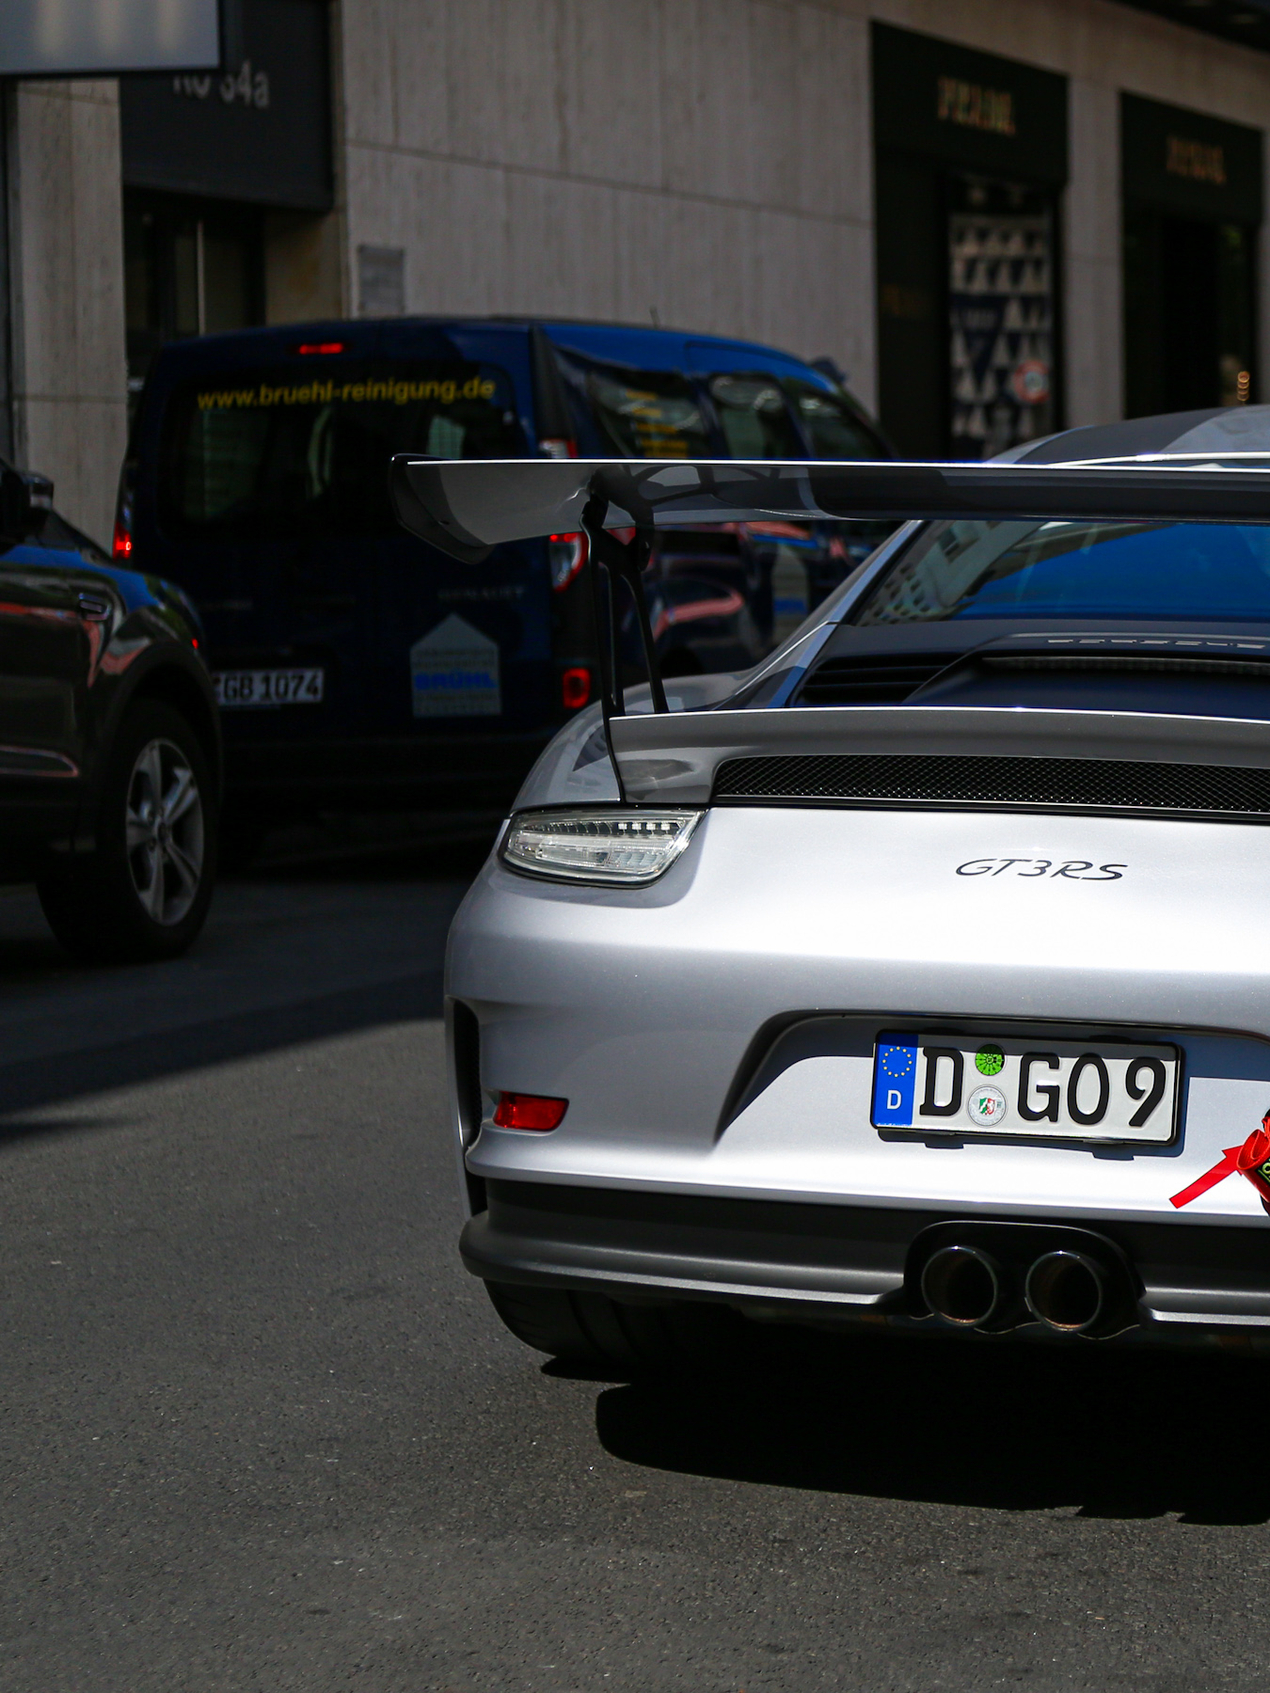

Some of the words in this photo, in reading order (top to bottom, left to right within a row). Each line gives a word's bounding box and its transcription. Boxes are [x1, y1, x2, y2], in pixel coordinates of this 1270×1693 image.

[196, 376, 497, 410] www.bruehl-reinigung.de
[260, 672, 320, 699] 1074
[919, 1046, 964, 1116] D
[887, 1089, 902, 1110] D
